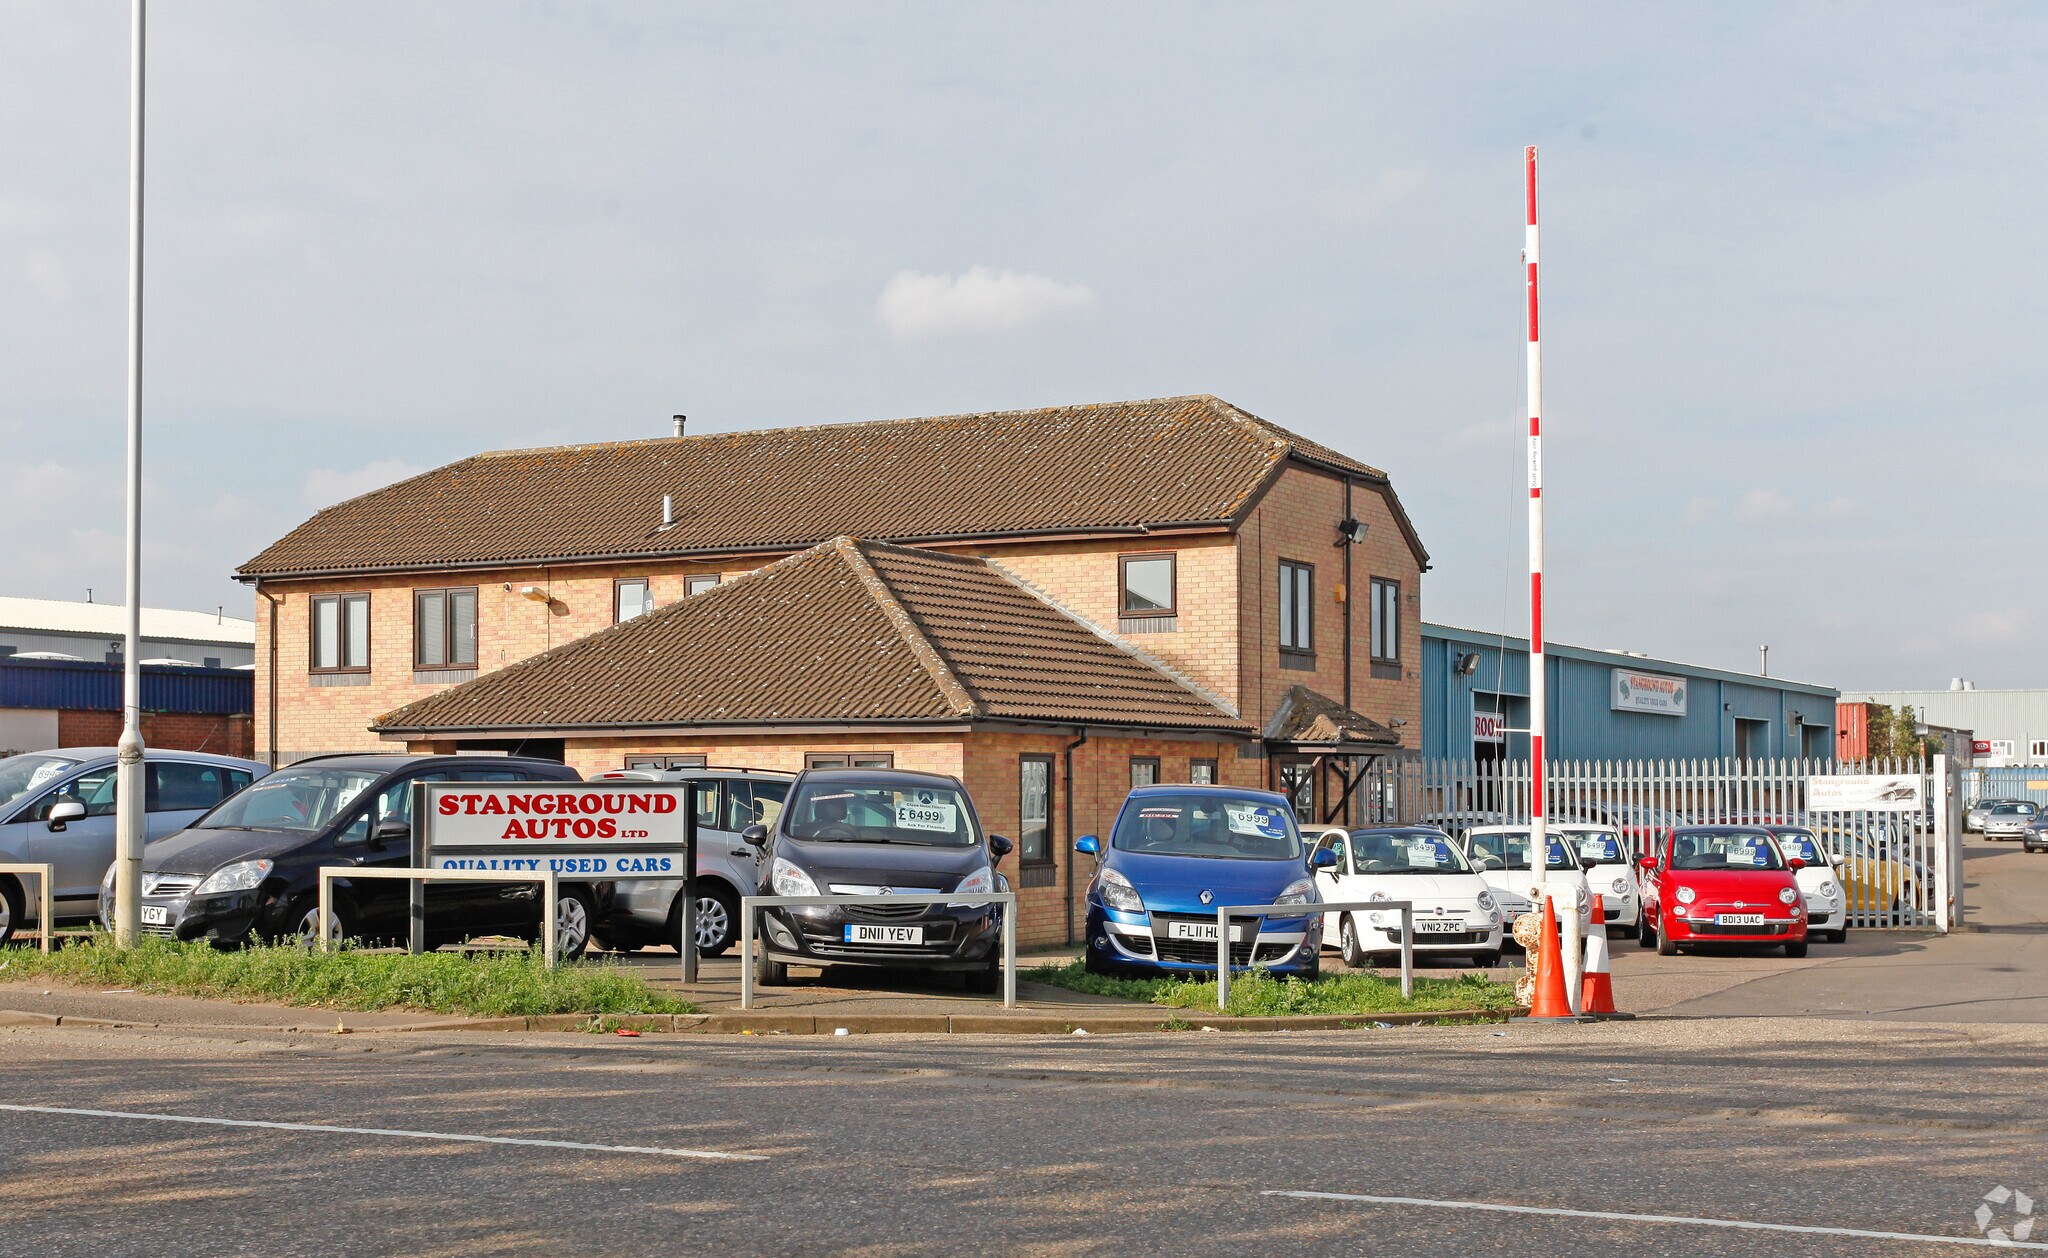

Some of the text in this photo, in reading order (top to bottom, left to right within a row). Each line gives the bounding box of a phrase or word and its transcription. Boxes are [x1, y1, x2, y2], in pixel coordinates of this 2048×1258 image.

[1474, 717, 1502, 737] ROOM
[1812, 777, 1870, 786] Stanground
[1812, 788, 1842, 796] Autos
[438, 794, 677, 816] STANGROUND
[1238, 813, 1268, 824] 6999
[501, 818, 649, 839] AUTOS LTD
[443, 858, 671, 873] QUALITY USED CARS
[1722, 915, 1760, 924] BD13 UAC
[1179, 925, 1202, 937] FL11
[1421, 923, 1460, 931] VN12 ZPC
[859, 926, 914, 941] DN11 YEV
